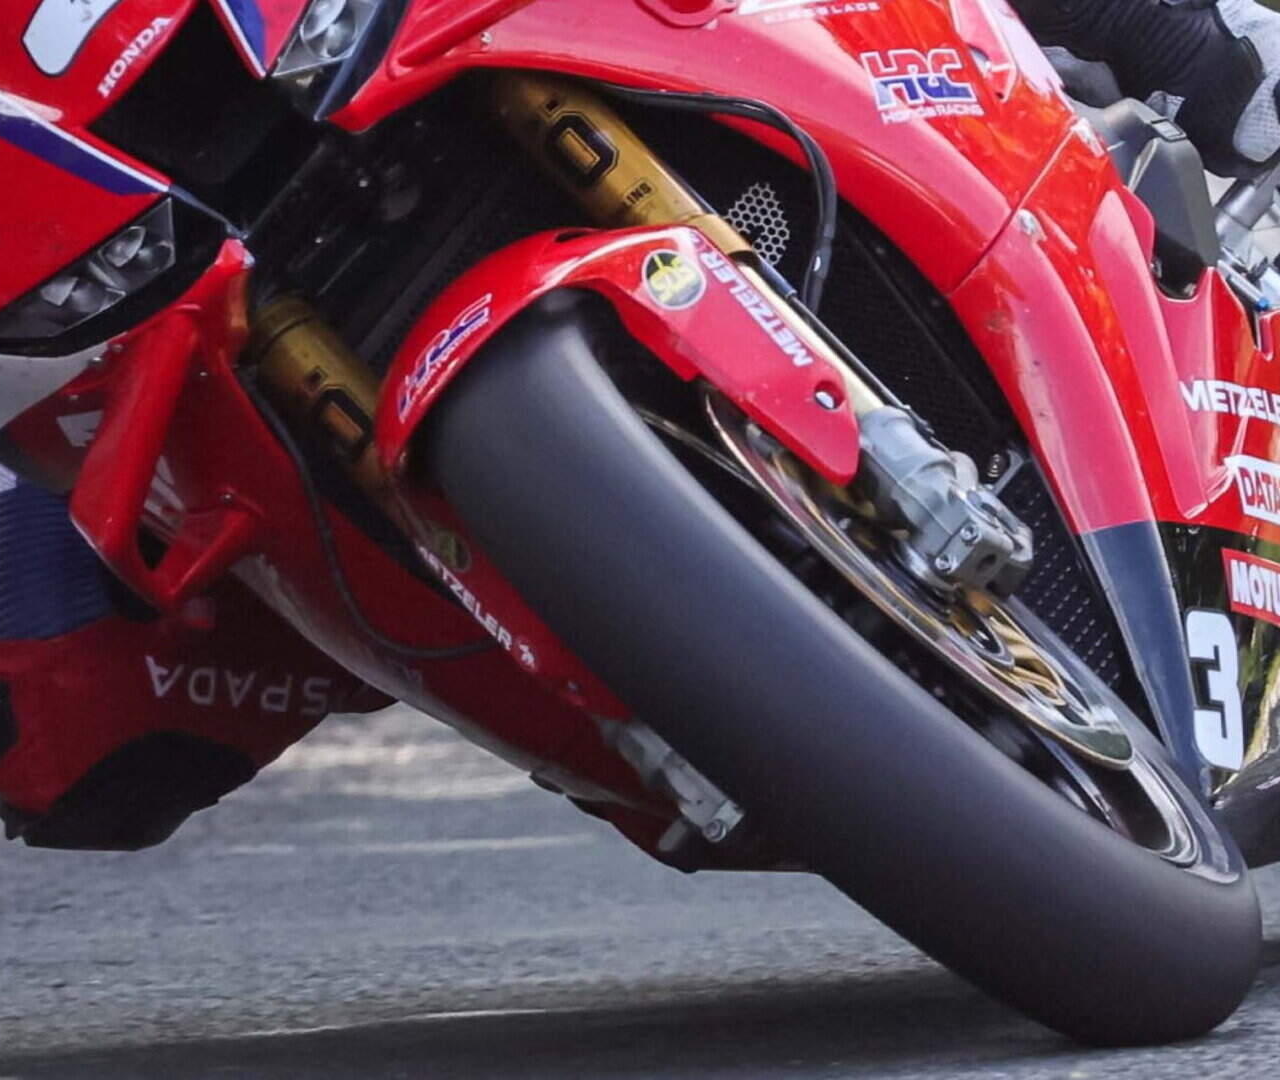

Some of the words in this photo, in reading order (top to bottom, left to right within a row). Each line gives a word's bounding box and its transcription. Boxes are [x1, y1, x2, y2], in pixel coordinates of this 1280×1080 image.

[97, 17, 174, 98] HONDA
[860, 48, 978, 110] HRC
[699, 251, 814, 367] METZELER
[145, 654, 332, 715] SPADA
[1186, 611, 1244, 772] 3
